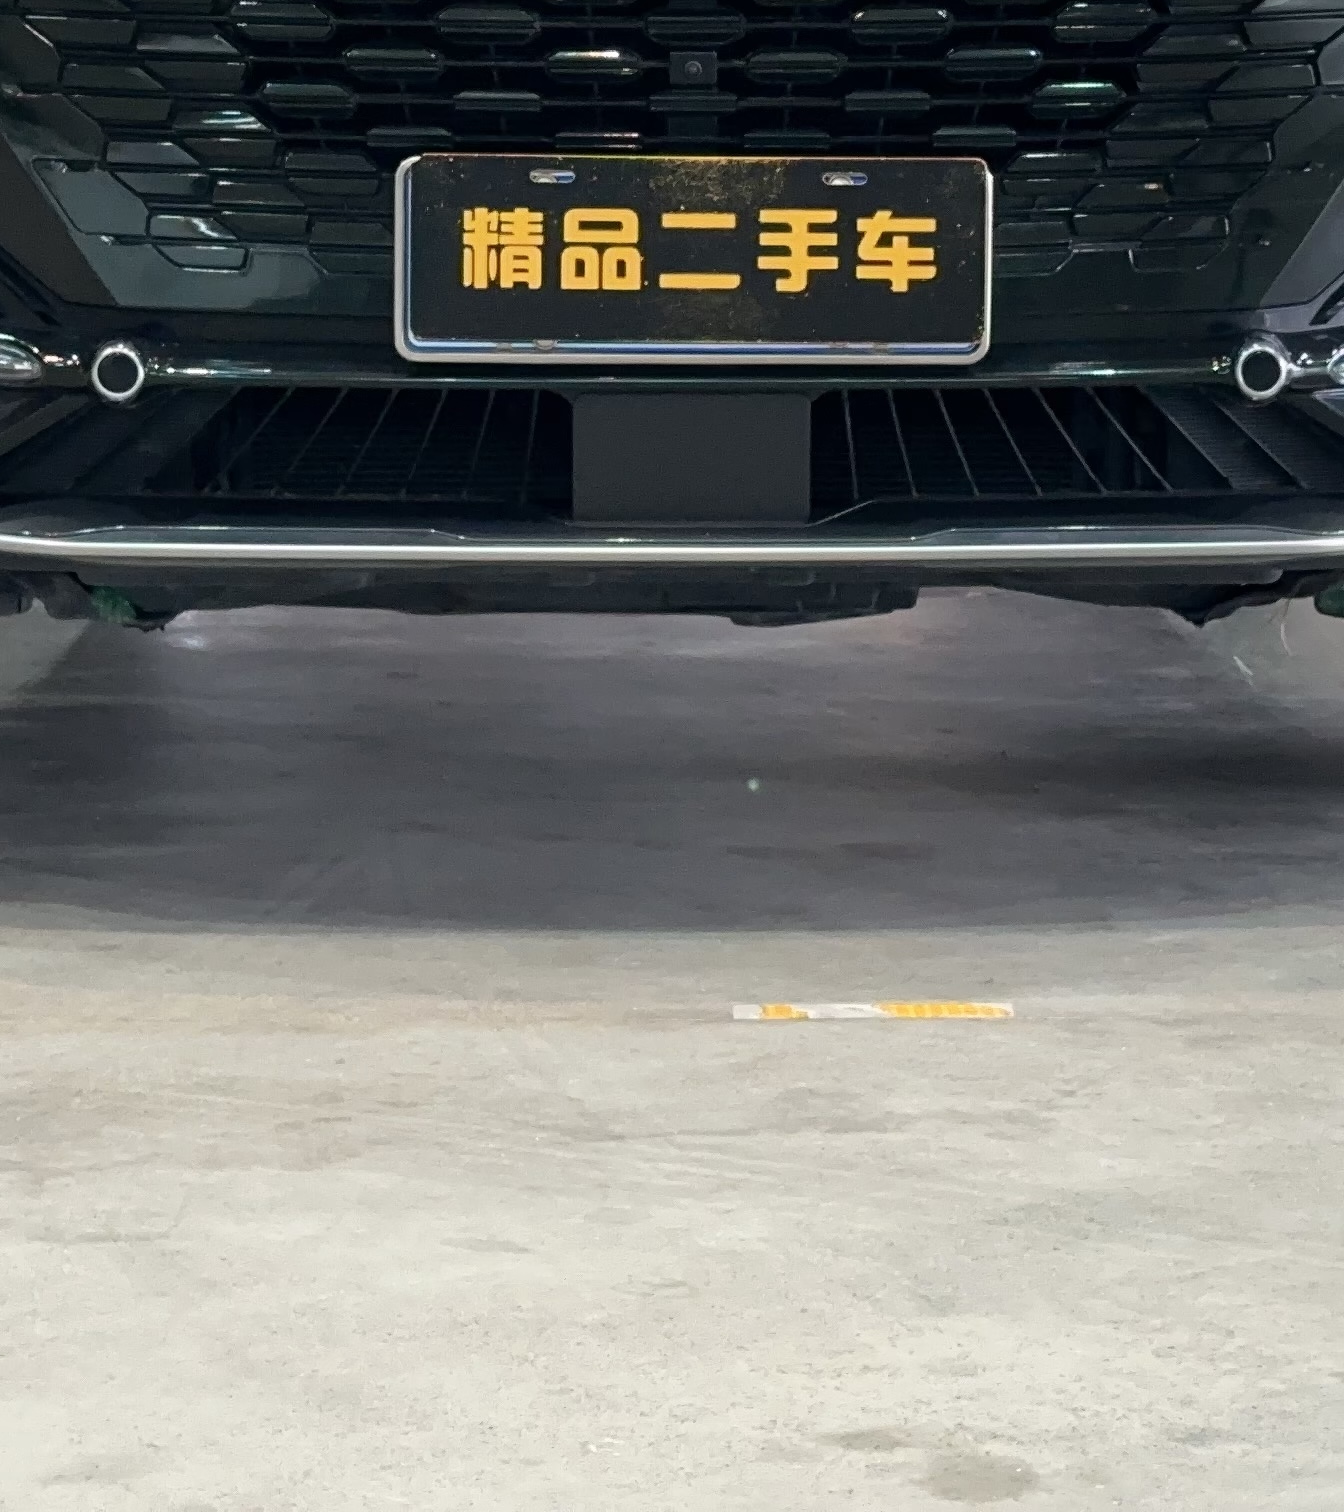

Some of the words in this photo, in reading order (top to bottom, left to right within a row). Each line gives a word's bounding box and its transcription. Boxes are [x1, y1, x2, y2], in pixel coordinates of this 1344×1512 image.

[462, 207, 937, 293] 精品二手车
